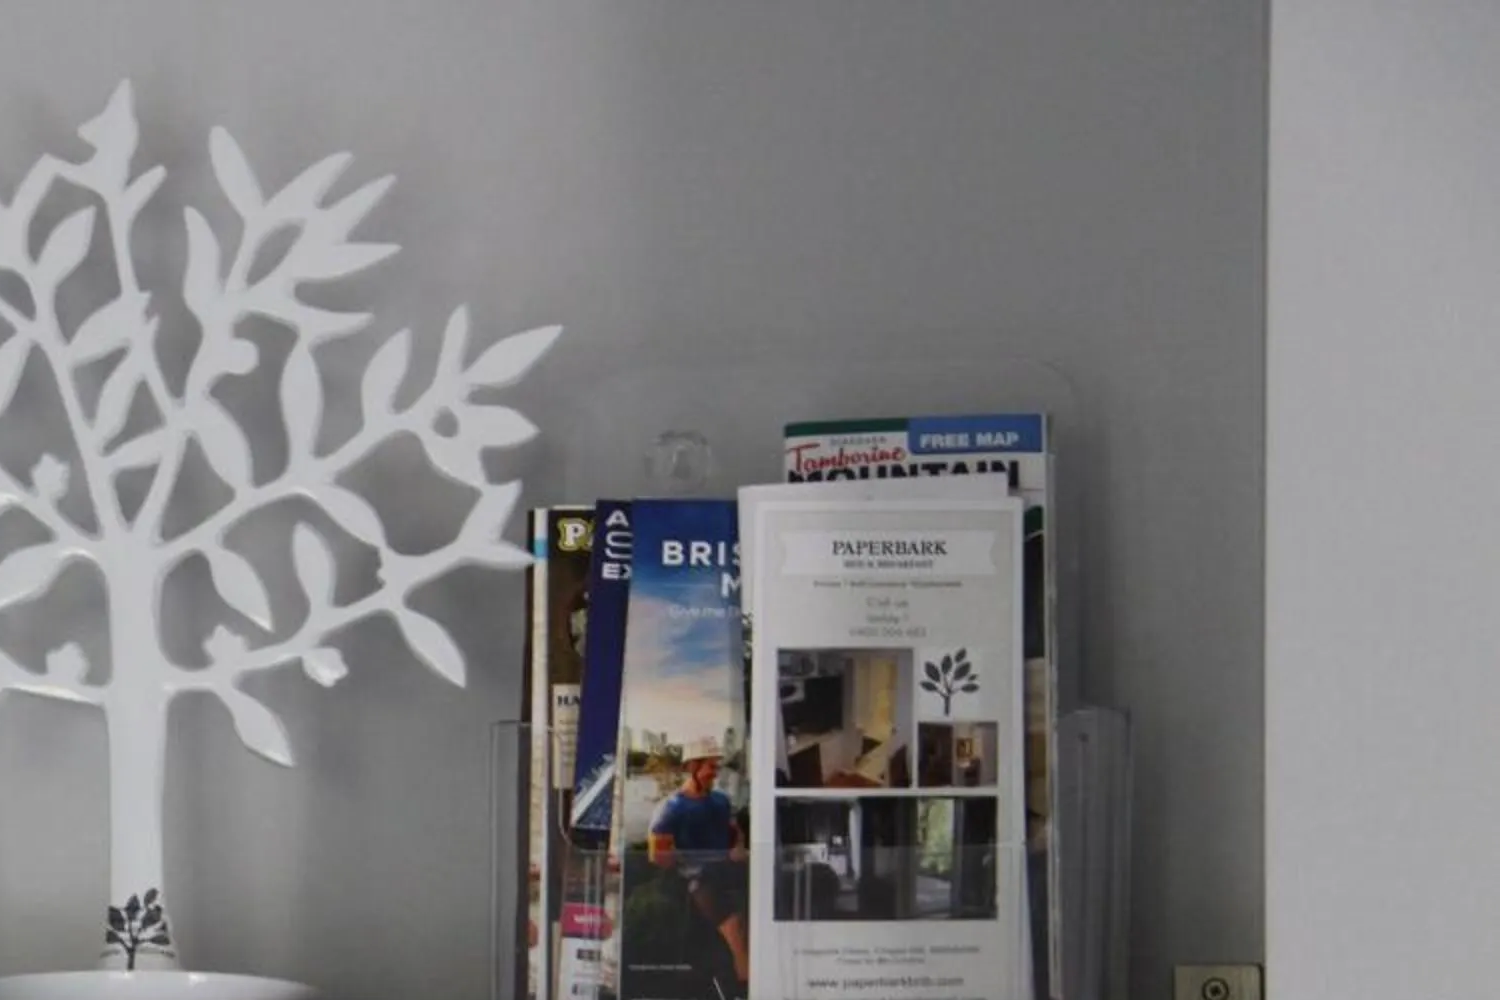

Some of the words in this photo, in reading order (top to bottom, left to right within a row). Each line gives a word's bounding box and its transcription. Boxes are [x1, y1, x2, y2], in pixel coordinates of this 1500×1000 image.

[919, 432, 970, 449] FREE
[976, 431, 1020, 447] MAP
[788, 442, 907, 474] Tamborine
[831, 539, 948, 556] PAPERBARK
